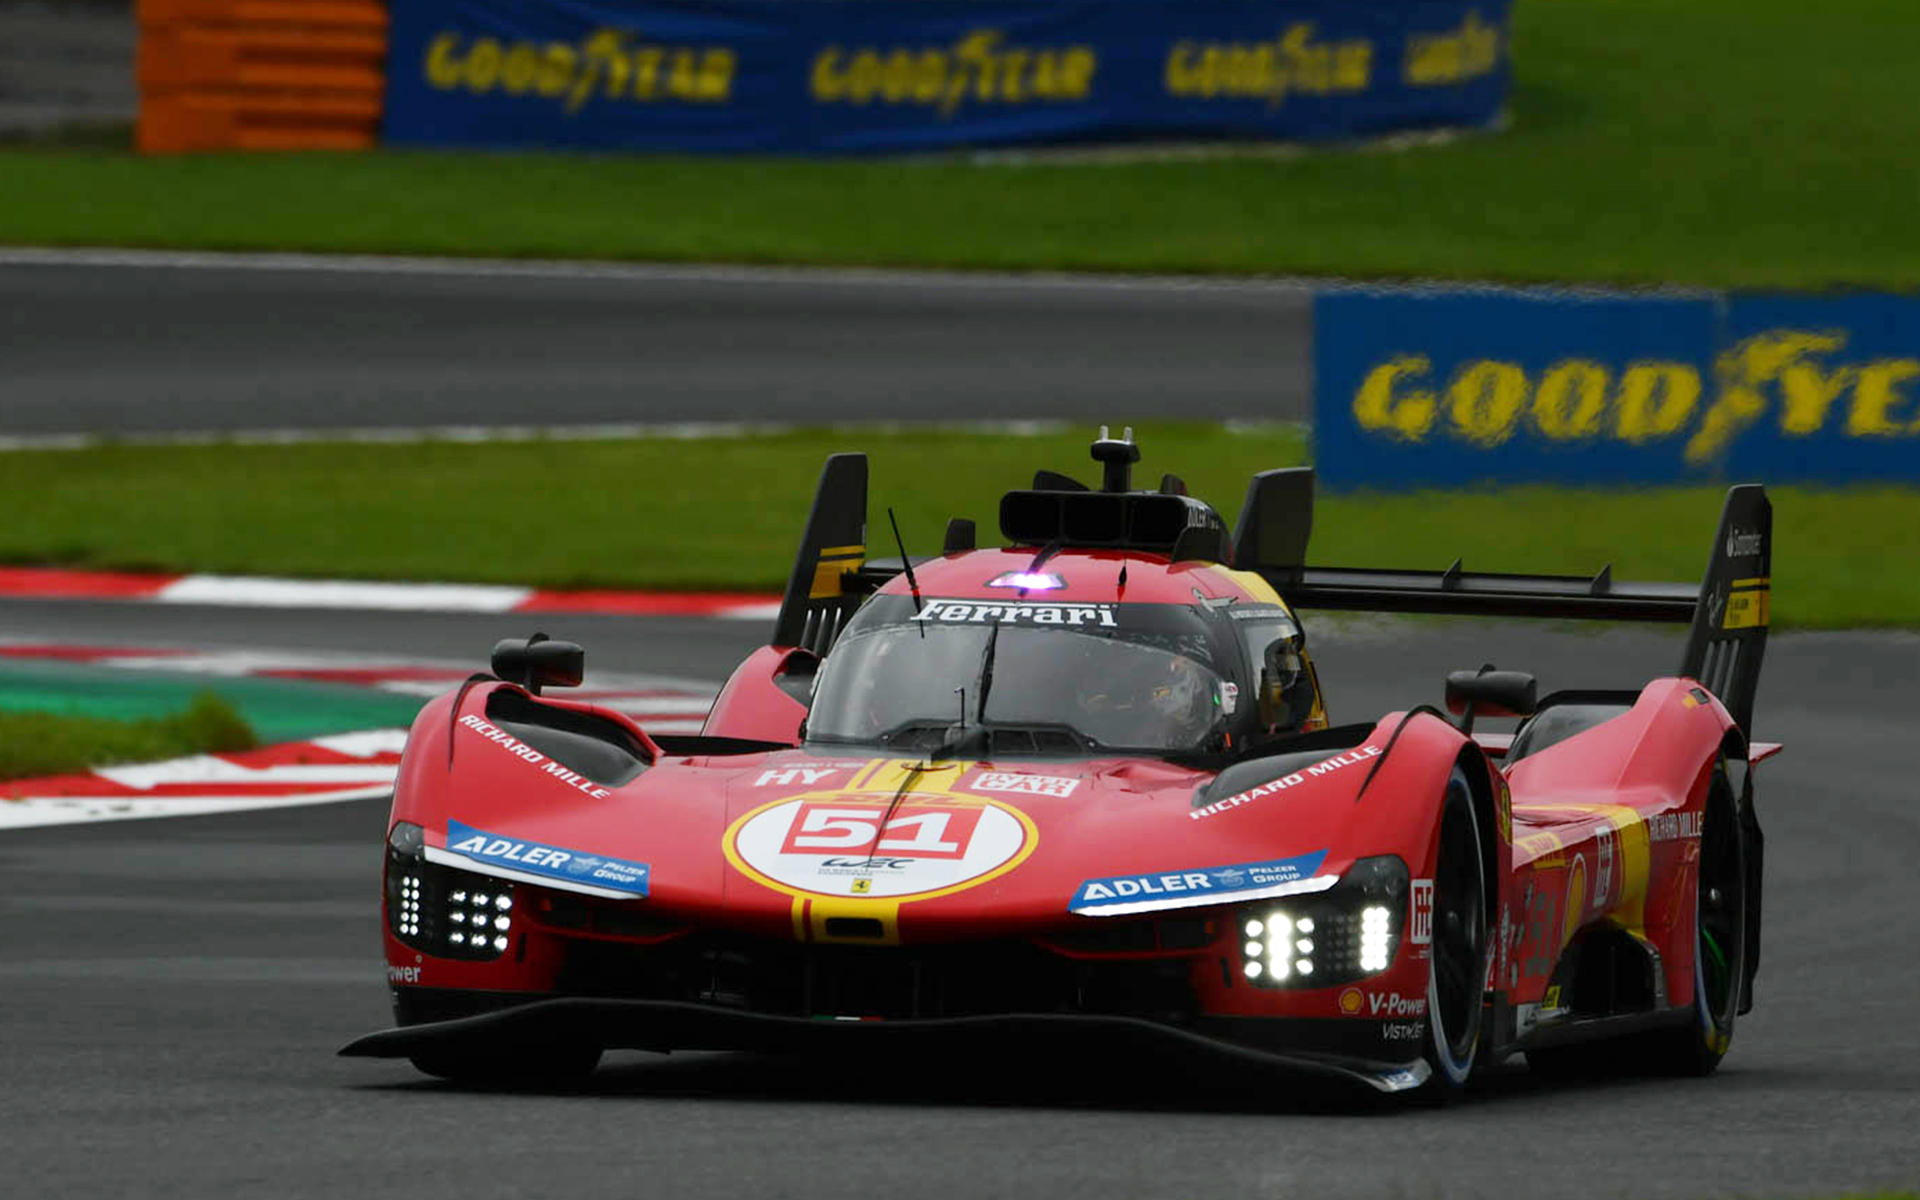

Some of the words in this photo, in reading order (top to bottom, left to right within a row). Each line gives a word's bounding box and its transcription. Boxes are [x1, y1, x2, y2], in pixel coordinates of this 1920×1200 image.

[425, 30, 736, 114] GOODYEAR
[909, 598, 1118, 626] Ferrari
[459, 713, 545, 764] RICHARD
[540, 761, 611, 800] MILLE
[1189, 772, 1305, 820] RICHARD
[1307, 745, 1384, 777] MILLE
[453, 835, 570, 869] ADLER
[793, 808, 959, 853] 51
[1083, 873, 1212, 901] ADLER
